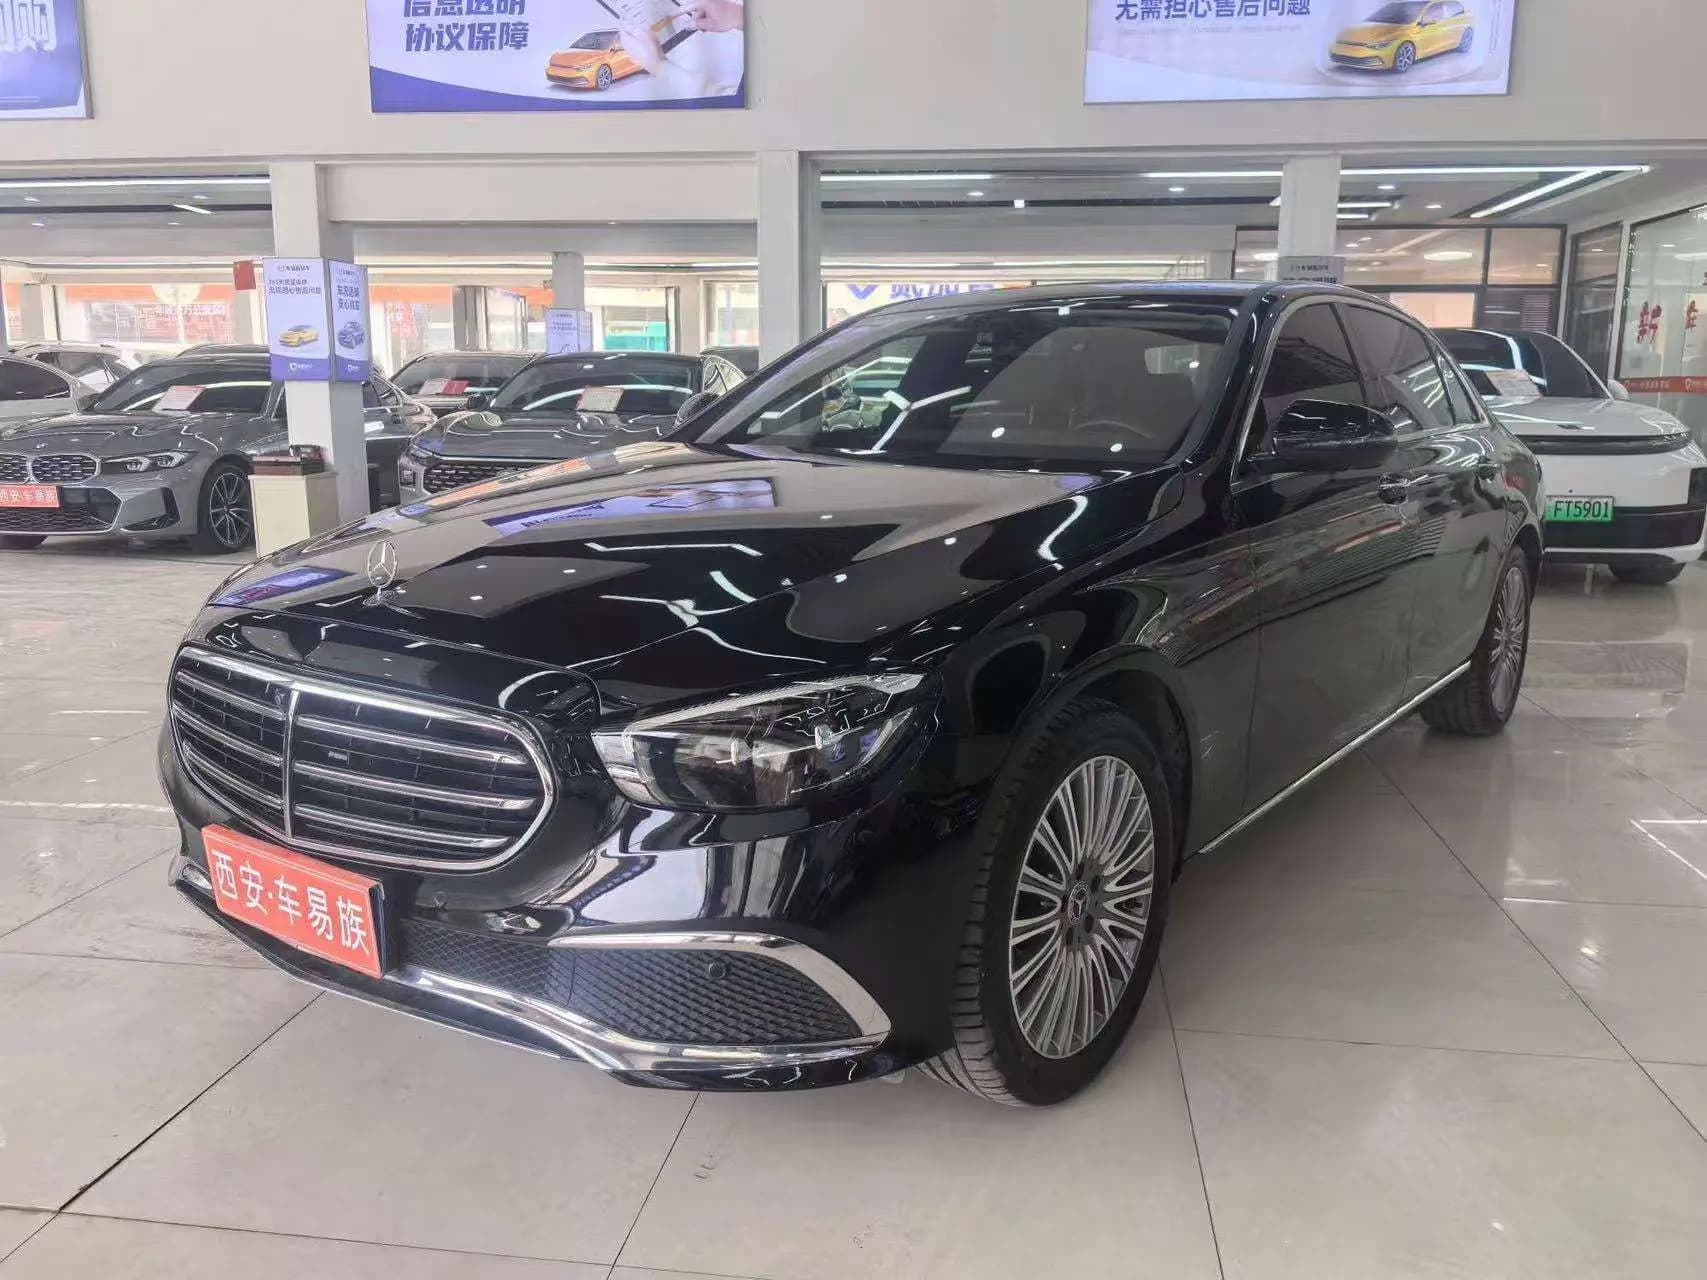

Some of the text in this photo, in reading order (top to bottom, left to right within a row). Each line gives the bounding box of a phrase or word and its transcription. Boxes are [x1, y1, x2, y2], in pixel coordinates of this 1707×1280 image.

[1115, 0, 1311, 21] 无需担心售后问题
[405, 22, 529, 51] 协议保障
[1554, 500, 1608, 518] FT5901
